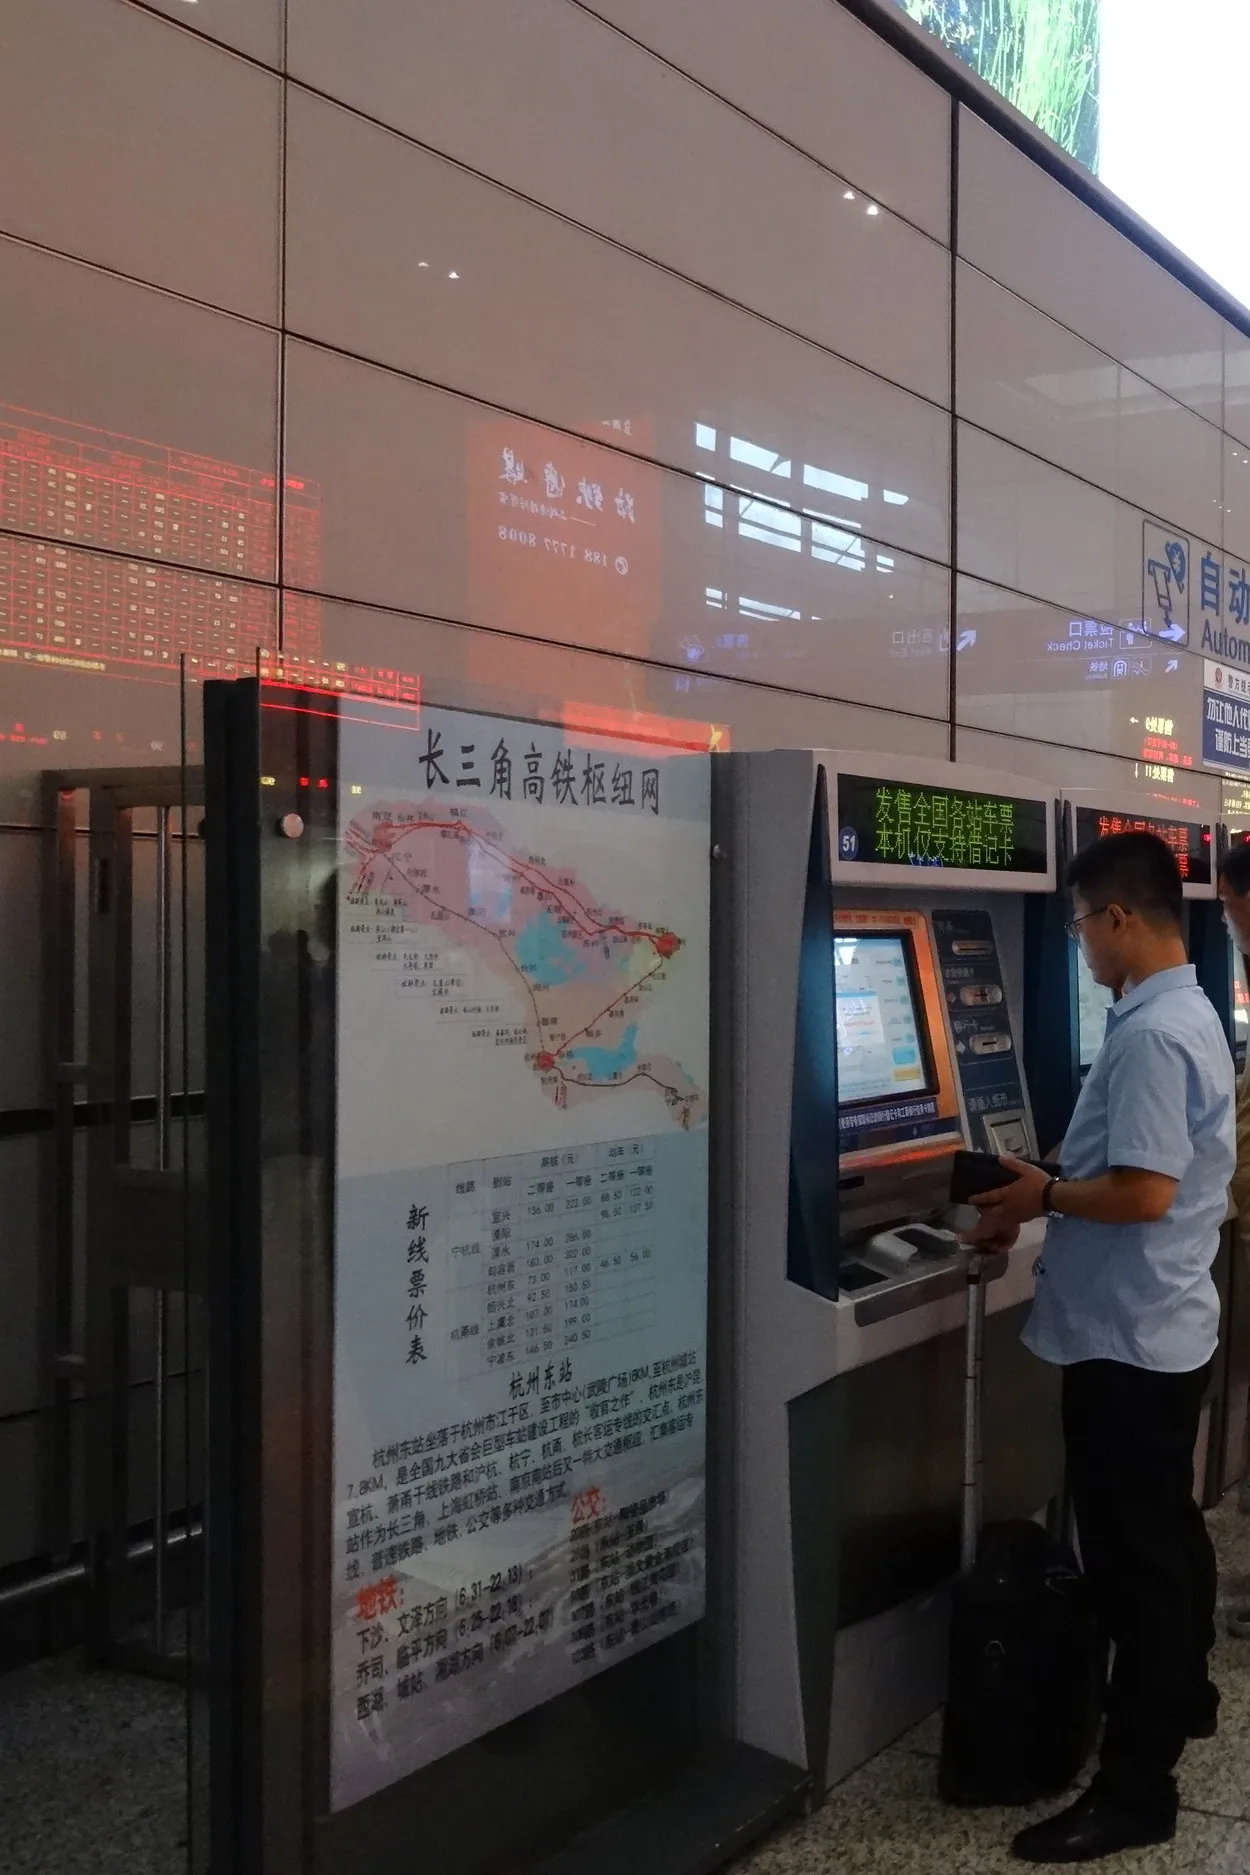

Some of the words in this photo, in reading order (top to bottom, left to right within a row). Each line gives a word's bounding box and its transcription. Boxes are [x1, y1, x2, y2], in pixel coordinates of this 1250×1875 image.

[419, 728, 660, 815] 长三角高铁枢纽网
[875, 786, 1014, 834] 发售全国各站车票
[842, 835, 856, 852] 51
[874, 825, 1015, 866] 本机仅支持借记卡
[527, 1180, 555, 1196] 二等座
[404, 1202, 429, 1366] 新线票价表
[508, 1357, 573, 1400] 杭州东站
